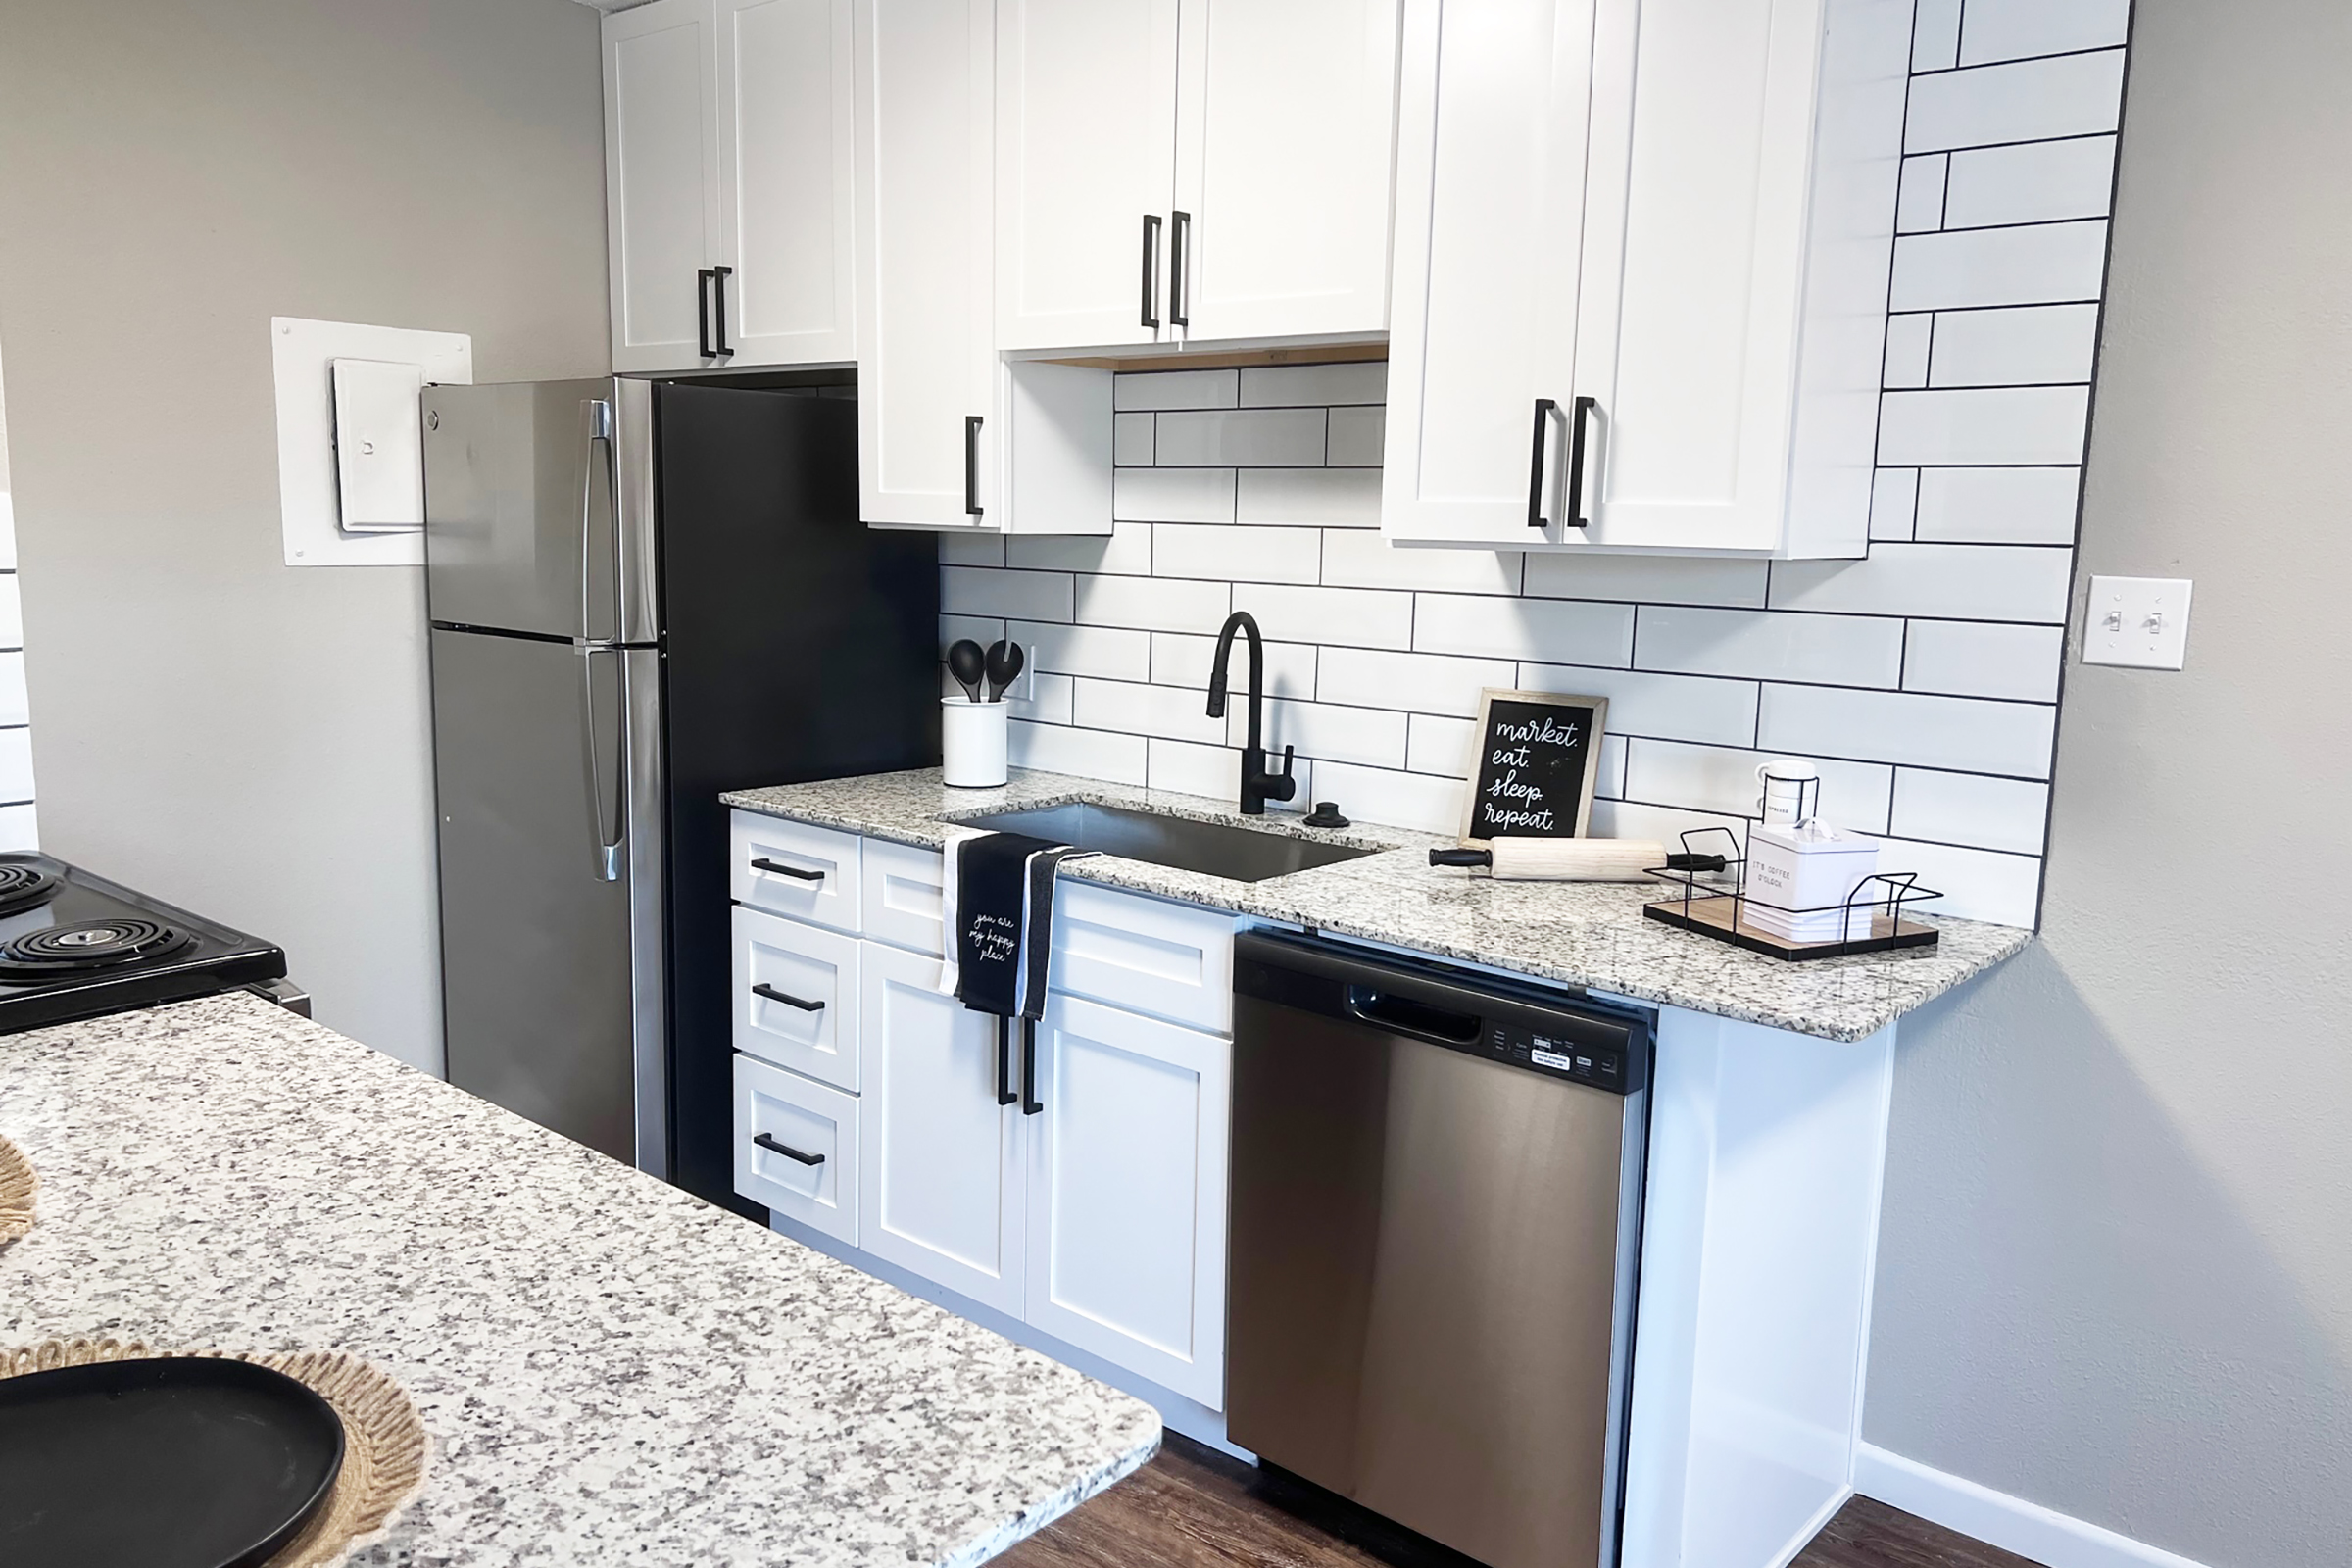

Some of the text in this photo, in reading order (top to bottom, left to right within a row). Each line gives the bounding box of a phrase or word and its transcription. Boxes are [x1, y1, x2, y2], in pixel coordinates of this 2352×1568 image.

[1496, 716, 1578, 747] market.
[1492, 745, 1531, 768] eat.
[1486, 769, 1544, 808] sleep.
[1484, 802, 1554, 831] repeat.
[1768, 865, 1790, 880] COFFEE
[974, 913, 1014, 930] you are
[968, 928, 1015, 955] my happy
[979, 944, 1005, 961] place
